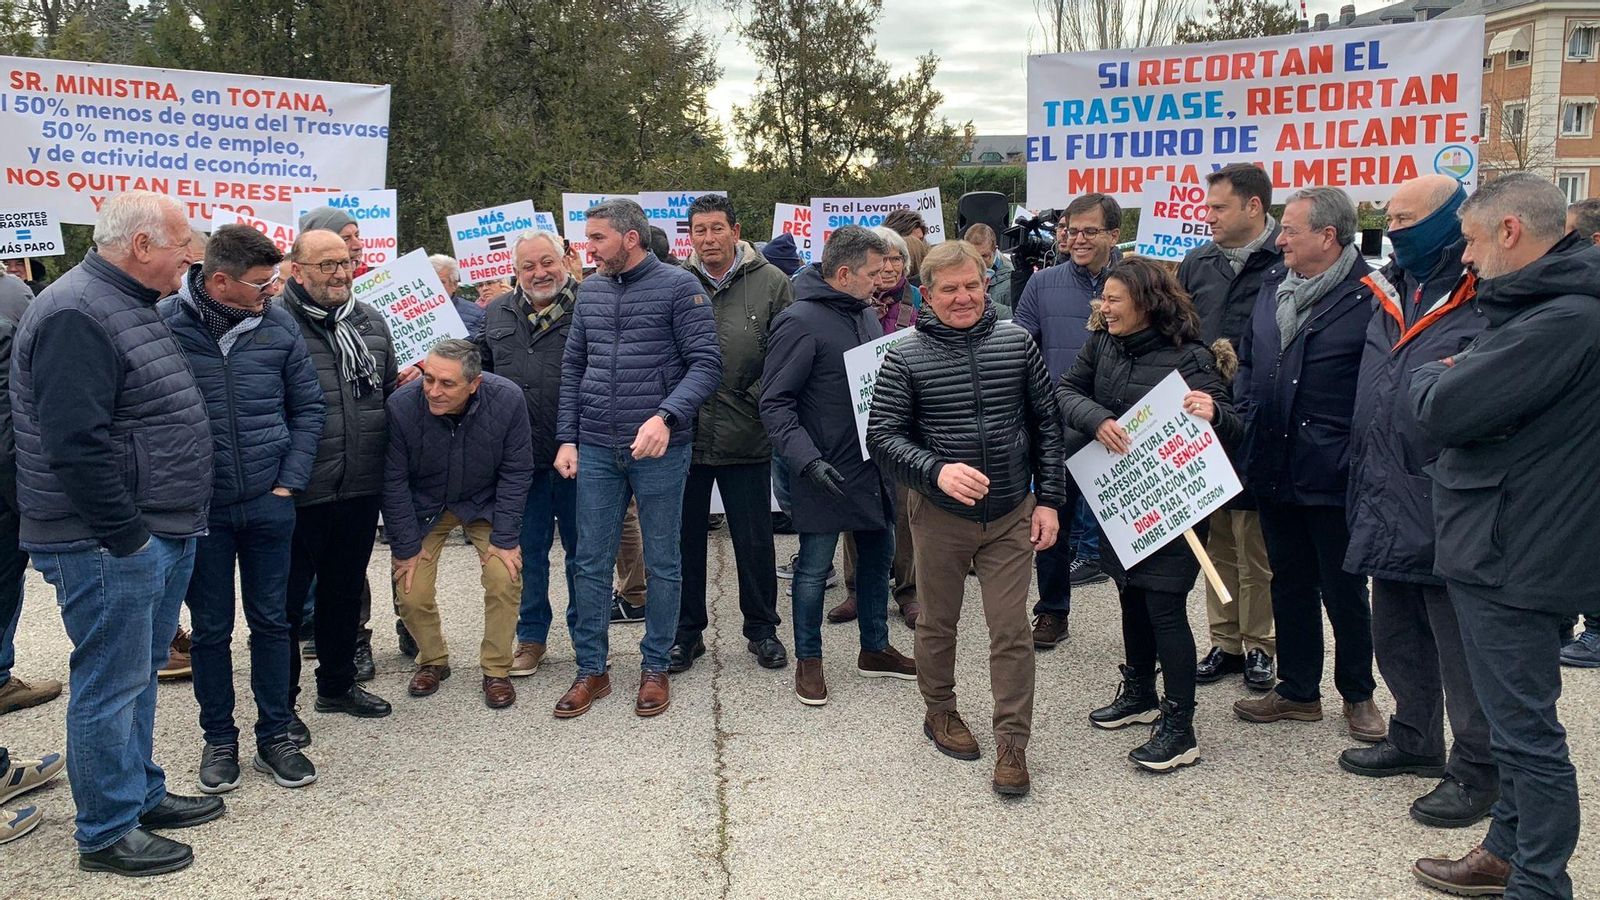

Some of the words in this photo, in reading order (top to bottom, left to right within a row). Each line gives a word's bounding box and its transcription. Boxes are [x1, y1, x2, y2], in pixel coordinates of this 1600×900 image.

[1098, 61, 1130, 89] SI
[1138, 44, 1333, 87] RECORTAN
[1344, 40, 1389, 72] EL
[10, 70, 48, 92] SR.
[55, 74, 185, 105] MINISTRA,
[191, 88, 220, 105] en
[227, 87, 333, 116] TOTANA,
[1043, 90, 1236, 127] TRASVASE,
[1247, 73, 1458, 116] RECORTAN
[14, 95, 69, 117] 50%
[76, 104, 153, 123] menos
[158, 106, 186, 125] de
[192, 112, 249, 131] agua
[254, 113, 287, 132] del
[293, 116, 389, 139] Trasvase
[42, 121, 97, 142] 50%
[104, 129, 180, 148] menos
[185, 131, 213, 149] de
[218, 136, 305, 158] empleo,
[1027, 136, 1057, 162] EL
[1066, 128, 1203, 161] FUTURO
[1213, 125, 1259, 154] DE
[1275, 112, 1480, 151] ALICANTE,
[27, 147, 41, 164] y
[47, 144, 75, 163] de
[81, 148, 188, 170] actividad
[194, 158, 318, 181] económica,
[1253, 155, 1419, 189] LMERIA
[6, 167, 60, 188] NOS
[67, 171, 169, 195] QUITAN
[177, 178, 206, 197] EL
[215, 181, 341, 201] PRESE
[1169, 185, 1205, 204] NO
[90, 195, 106, 213] Y
[328, 194, 360, 208] MÁS
[823, 202, 842, 212] En
[842, 202, 854, 213] el
[456, 217, 533, 241] DESALACIÓN
[477, 210, 505, 226] MÁS
[828, 215, 855, 227] SIN
[1181, 222, 1213, 236] DEL
[0, 242, 22, 254] MÁS
[25, 241, 55, 252] PARO
[459, 253, 484, 269] MÁS
[470, 260, 514, 280] ENERGÉ
[390, 294, 421, 314] SABIO,
[421, 287, 435, 300] LA
[398, 284, 411, 297] ES
[412, 278, 426, 291] LA
[390, 317, 403, 329] AL
[402, 294, 446, 321] SENCILLO
[408, 326, 434, 345] TODO
[1110, 431, 1164, 480] AGRICULTURA
[1162, 421, 1176, 438] ES
[1174, 411, 1189, 428] LA
[1141, 455, 1160, 473] DEL
[1157, 433, 1188, 460] SABIO,
[1185, 423, 1200, 439] LA
[1120, 472, 1160, 509] ADECUADA
[1160, 463, 1174, 478] AL
[1172, 430, 1214, 469] SENCILLO
[1119, 512, 1129, 525] Y
[1128, 504, 1142, 520] LA
[1133, 509, 1162, 534] DIGNA
[1160, 493, 1184, 516] PARA
[1182, 475, 1207, 499] TODO
[1130, 523, 1167, 554] HOMBRE
